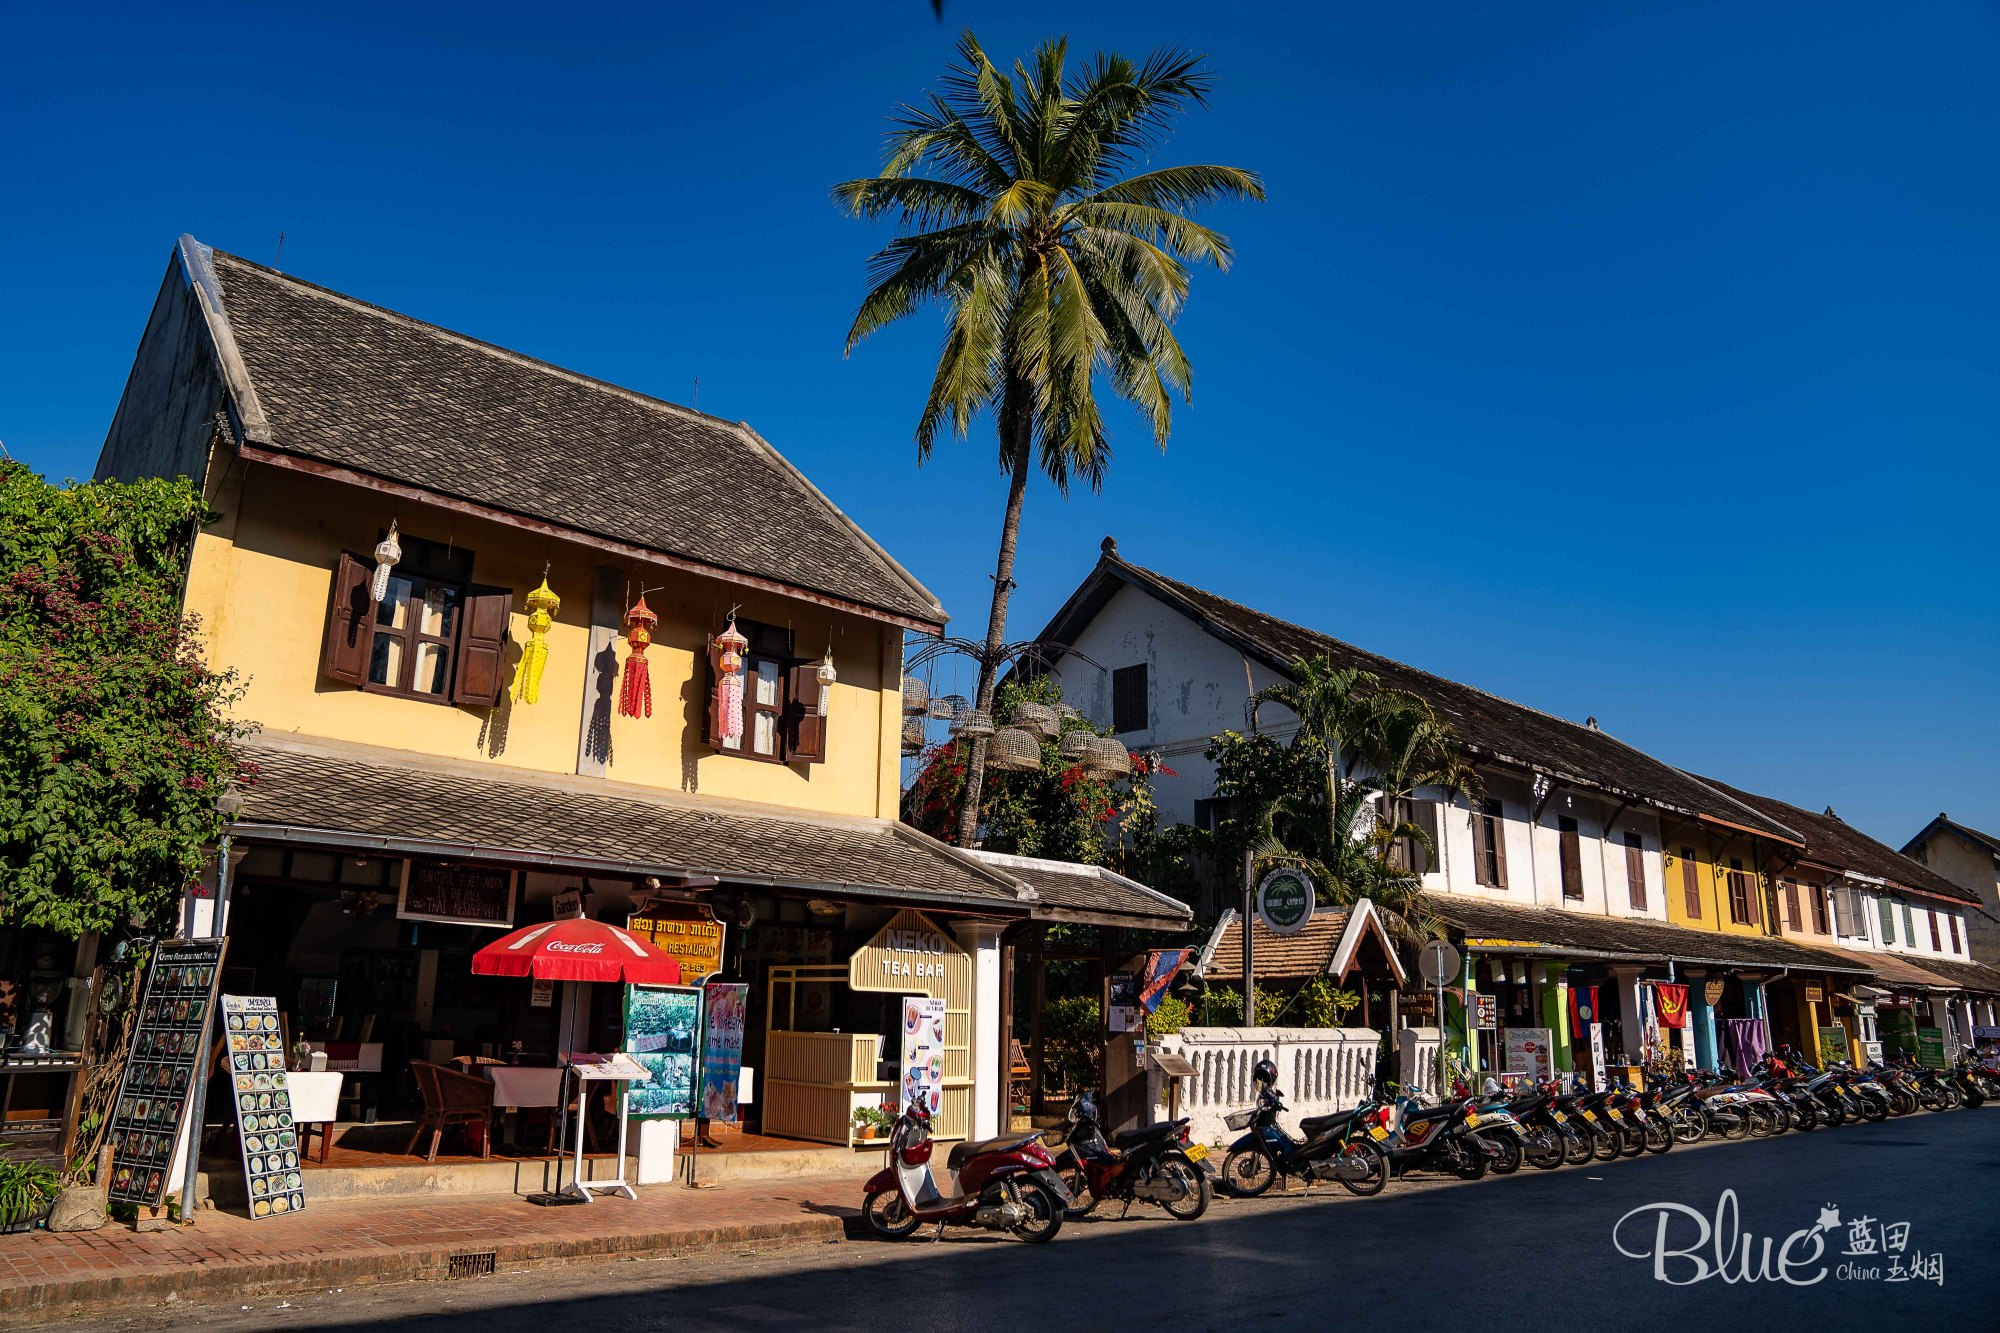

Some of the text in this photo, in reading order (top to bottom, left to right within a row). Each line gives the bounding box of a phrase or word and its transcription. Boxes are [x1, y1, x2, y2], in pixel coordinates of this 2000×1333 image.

[556, 899, 578, 914] Garden
[546, 941, 606, 954] Coca-Cola
[668, 941, 718, 958] RESTAURANT
[886, 928, 946, 956] NEKO
[882, 960, 944, 977] TEA BAR
